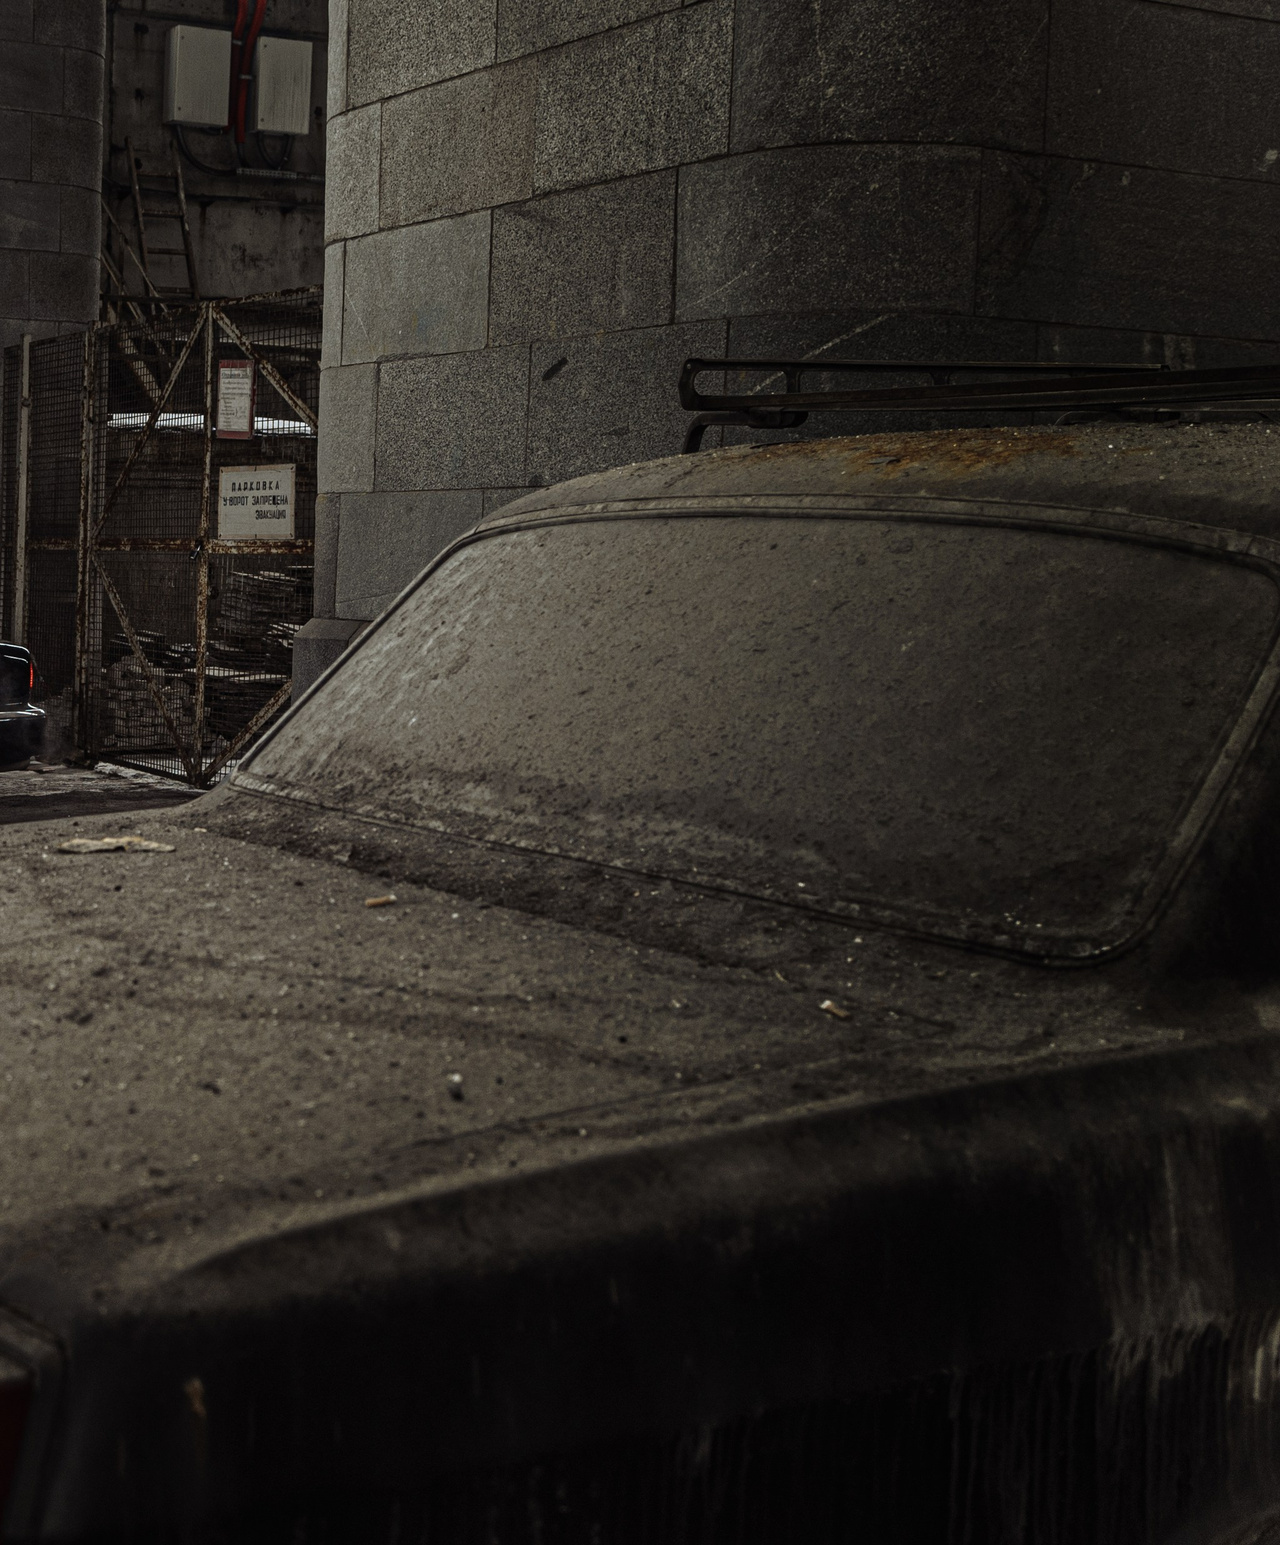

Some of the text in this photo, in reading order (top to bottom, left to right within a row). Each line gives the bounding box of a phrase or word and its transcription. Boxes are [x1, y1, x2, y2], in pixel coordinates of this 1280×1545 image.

[231, 480, 280, 492] ПАРКОВКА
[222, 496, 228, 506] У
[228, 495, 249, 506] ВОРОТ
